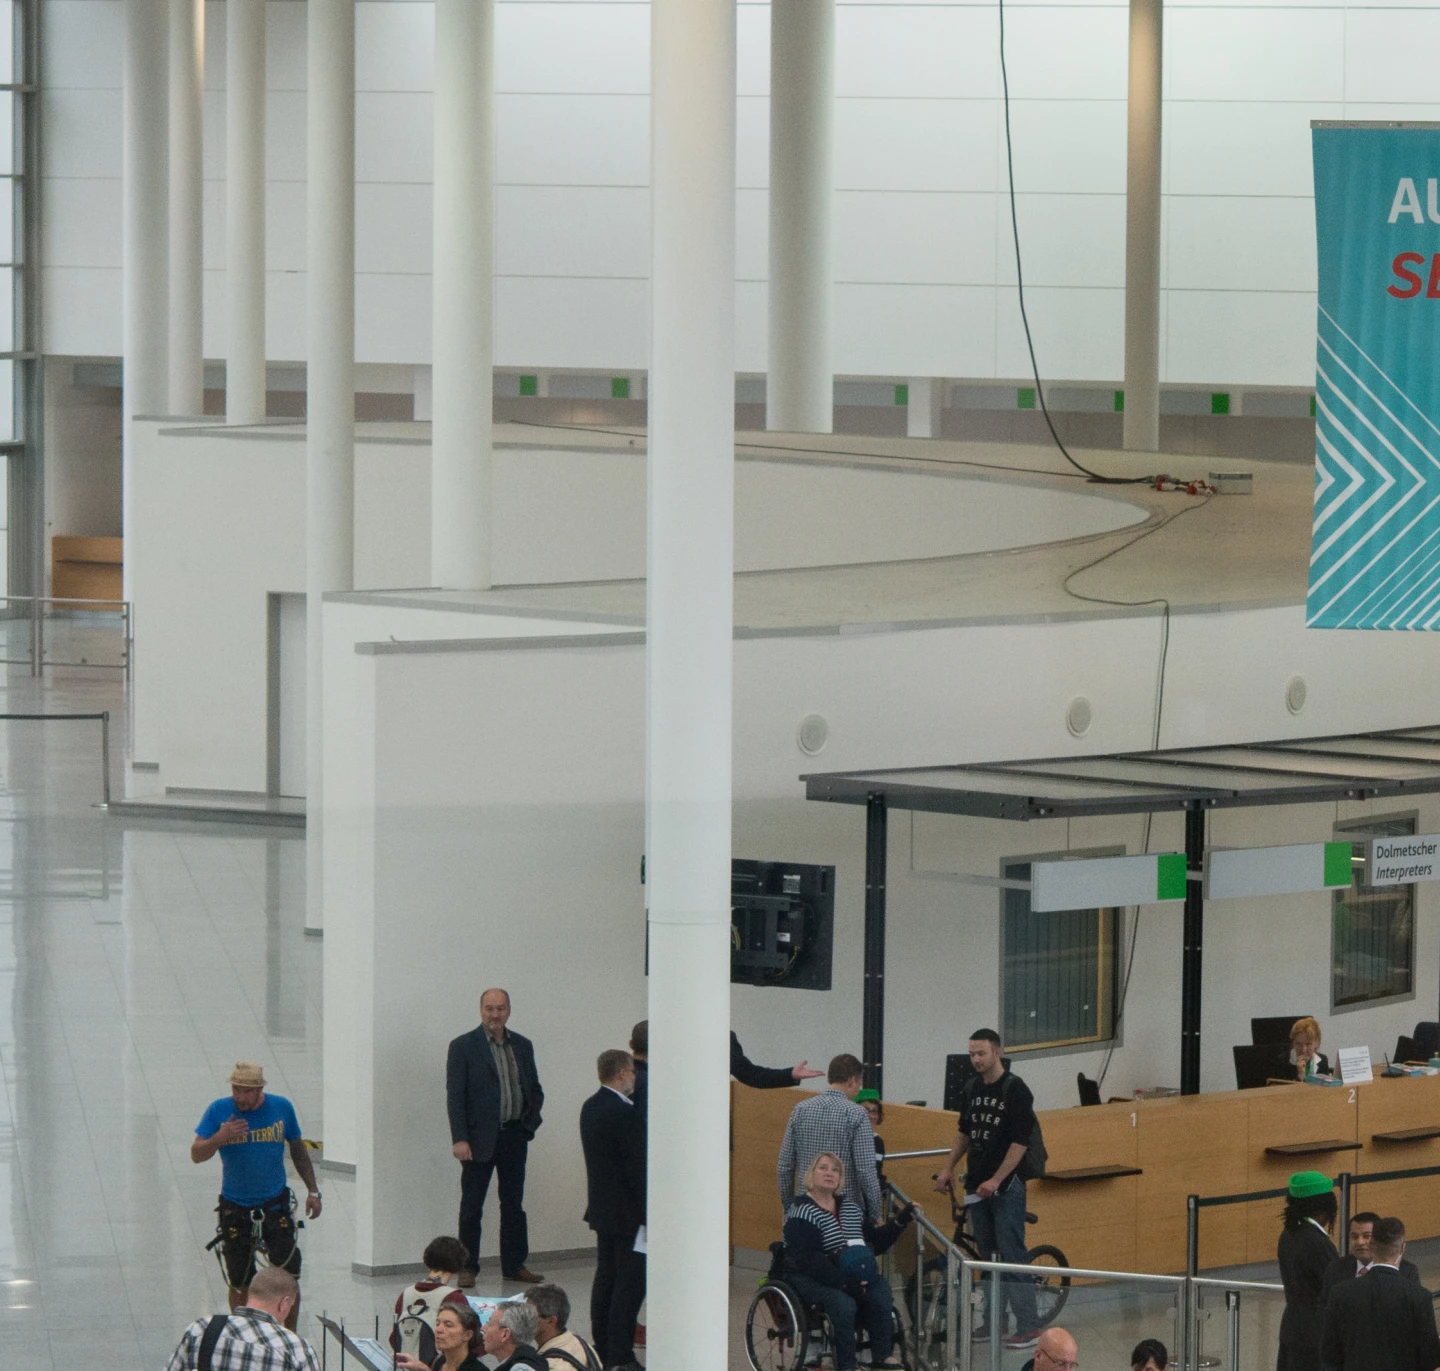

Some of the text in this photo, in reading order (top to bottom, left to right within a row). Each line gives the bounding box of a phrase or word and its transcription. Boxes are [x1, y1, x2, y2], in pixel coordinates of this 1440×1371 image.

[1376, 842, 1437, 860] Dolmetscher
[1376, 864, 1433, 881] Interpreters
[1347, 1088, 1356, 1104] 2
[1130, 1112, 1136, 1127] 1
